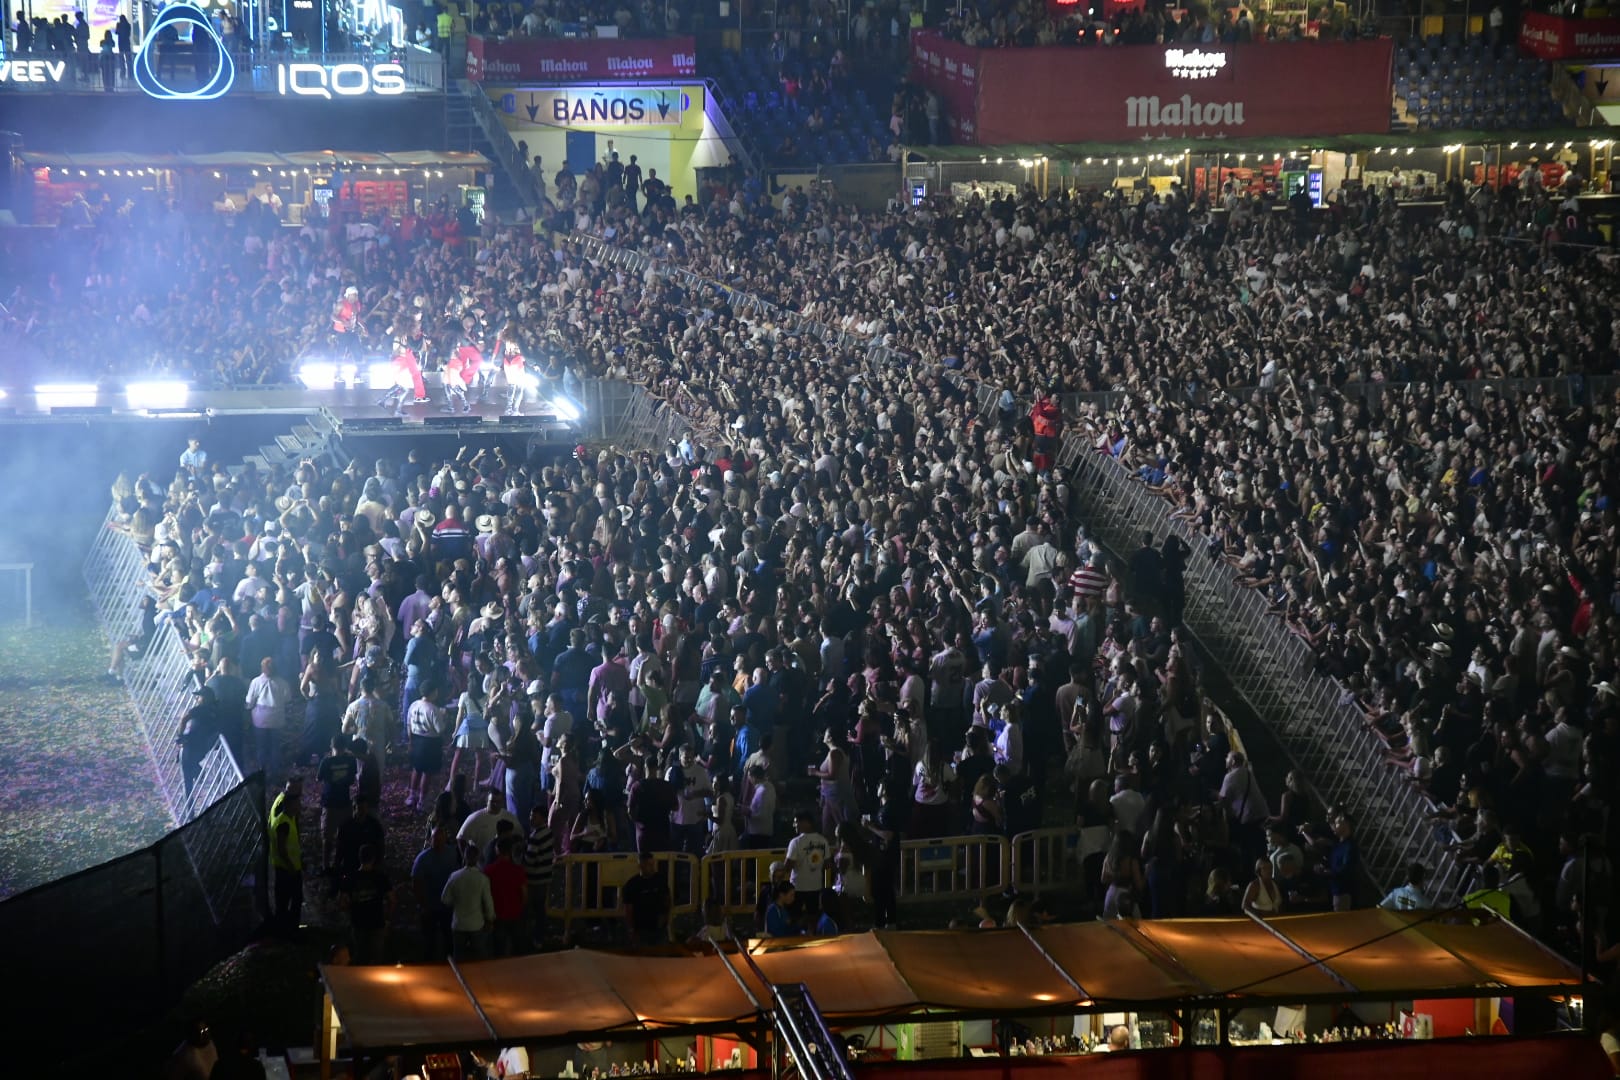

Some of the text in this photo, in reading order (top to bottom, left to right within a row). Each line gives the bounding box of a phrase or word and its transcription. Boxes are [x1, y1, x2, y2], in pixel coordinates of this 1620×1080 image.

[540, 58, 588, 73] Mahou
[607, 56, 653, 71] Mahou
[1165, 48, 1227, 68] Mahou
[0, 60, 66, 82] VEEV
[278, 63, 406, 100] IQOS
[553, 92, 645, 121] BAÑOS
[1125, 93, 1245, 127] Mahou
